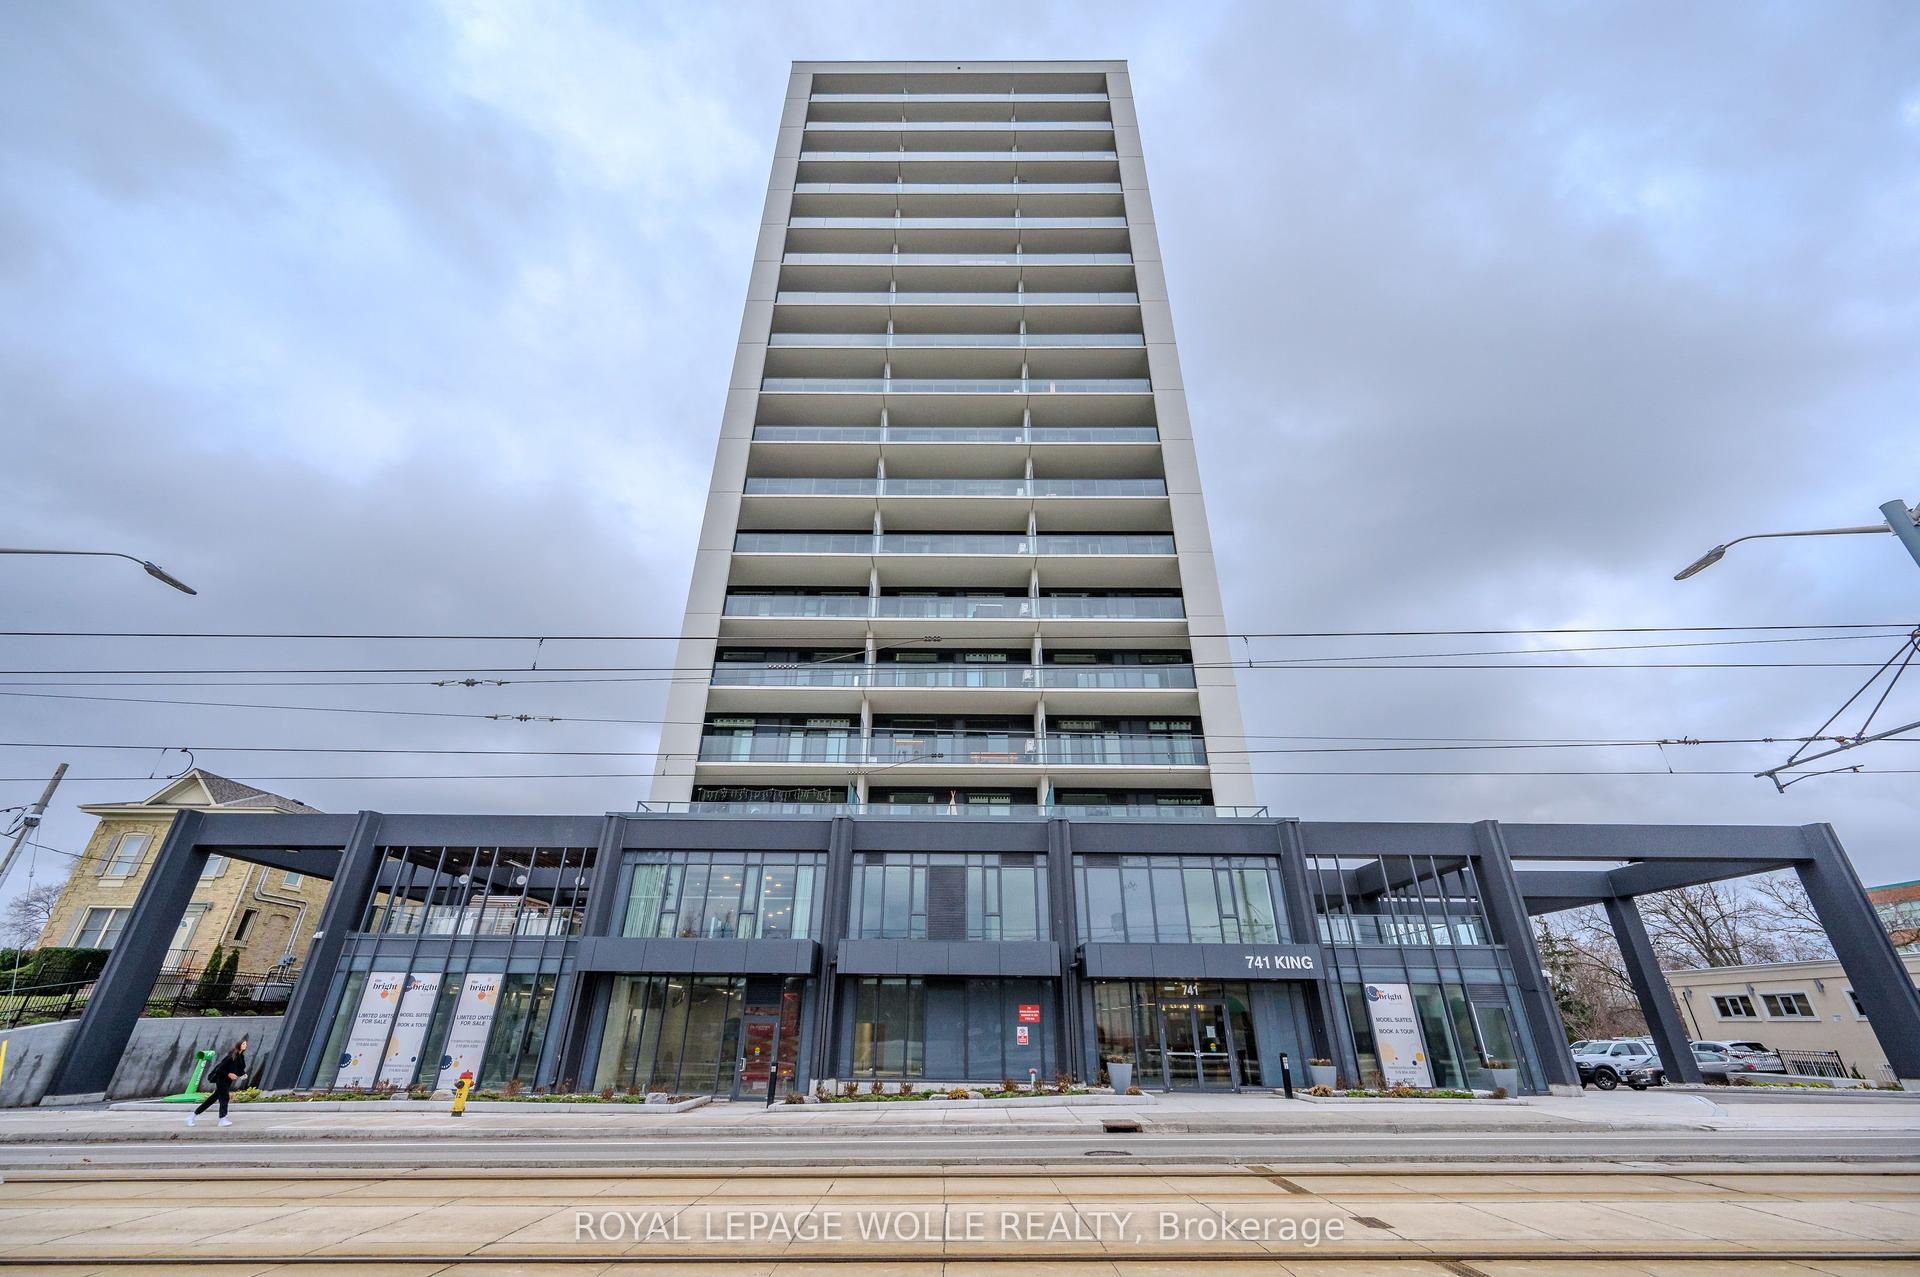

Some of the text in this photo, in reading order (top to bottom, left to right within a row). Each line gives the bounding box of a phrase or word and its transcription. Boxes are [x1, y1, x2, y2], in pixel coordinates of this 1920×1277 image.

[1245, 955, 1314, 970] 741 KING
[373, 982, 398, 992] bright
[413, 983, 438, 992] bright
[469, 984, 495, 993] bright
[1181, 984, 1199, 996] 741
